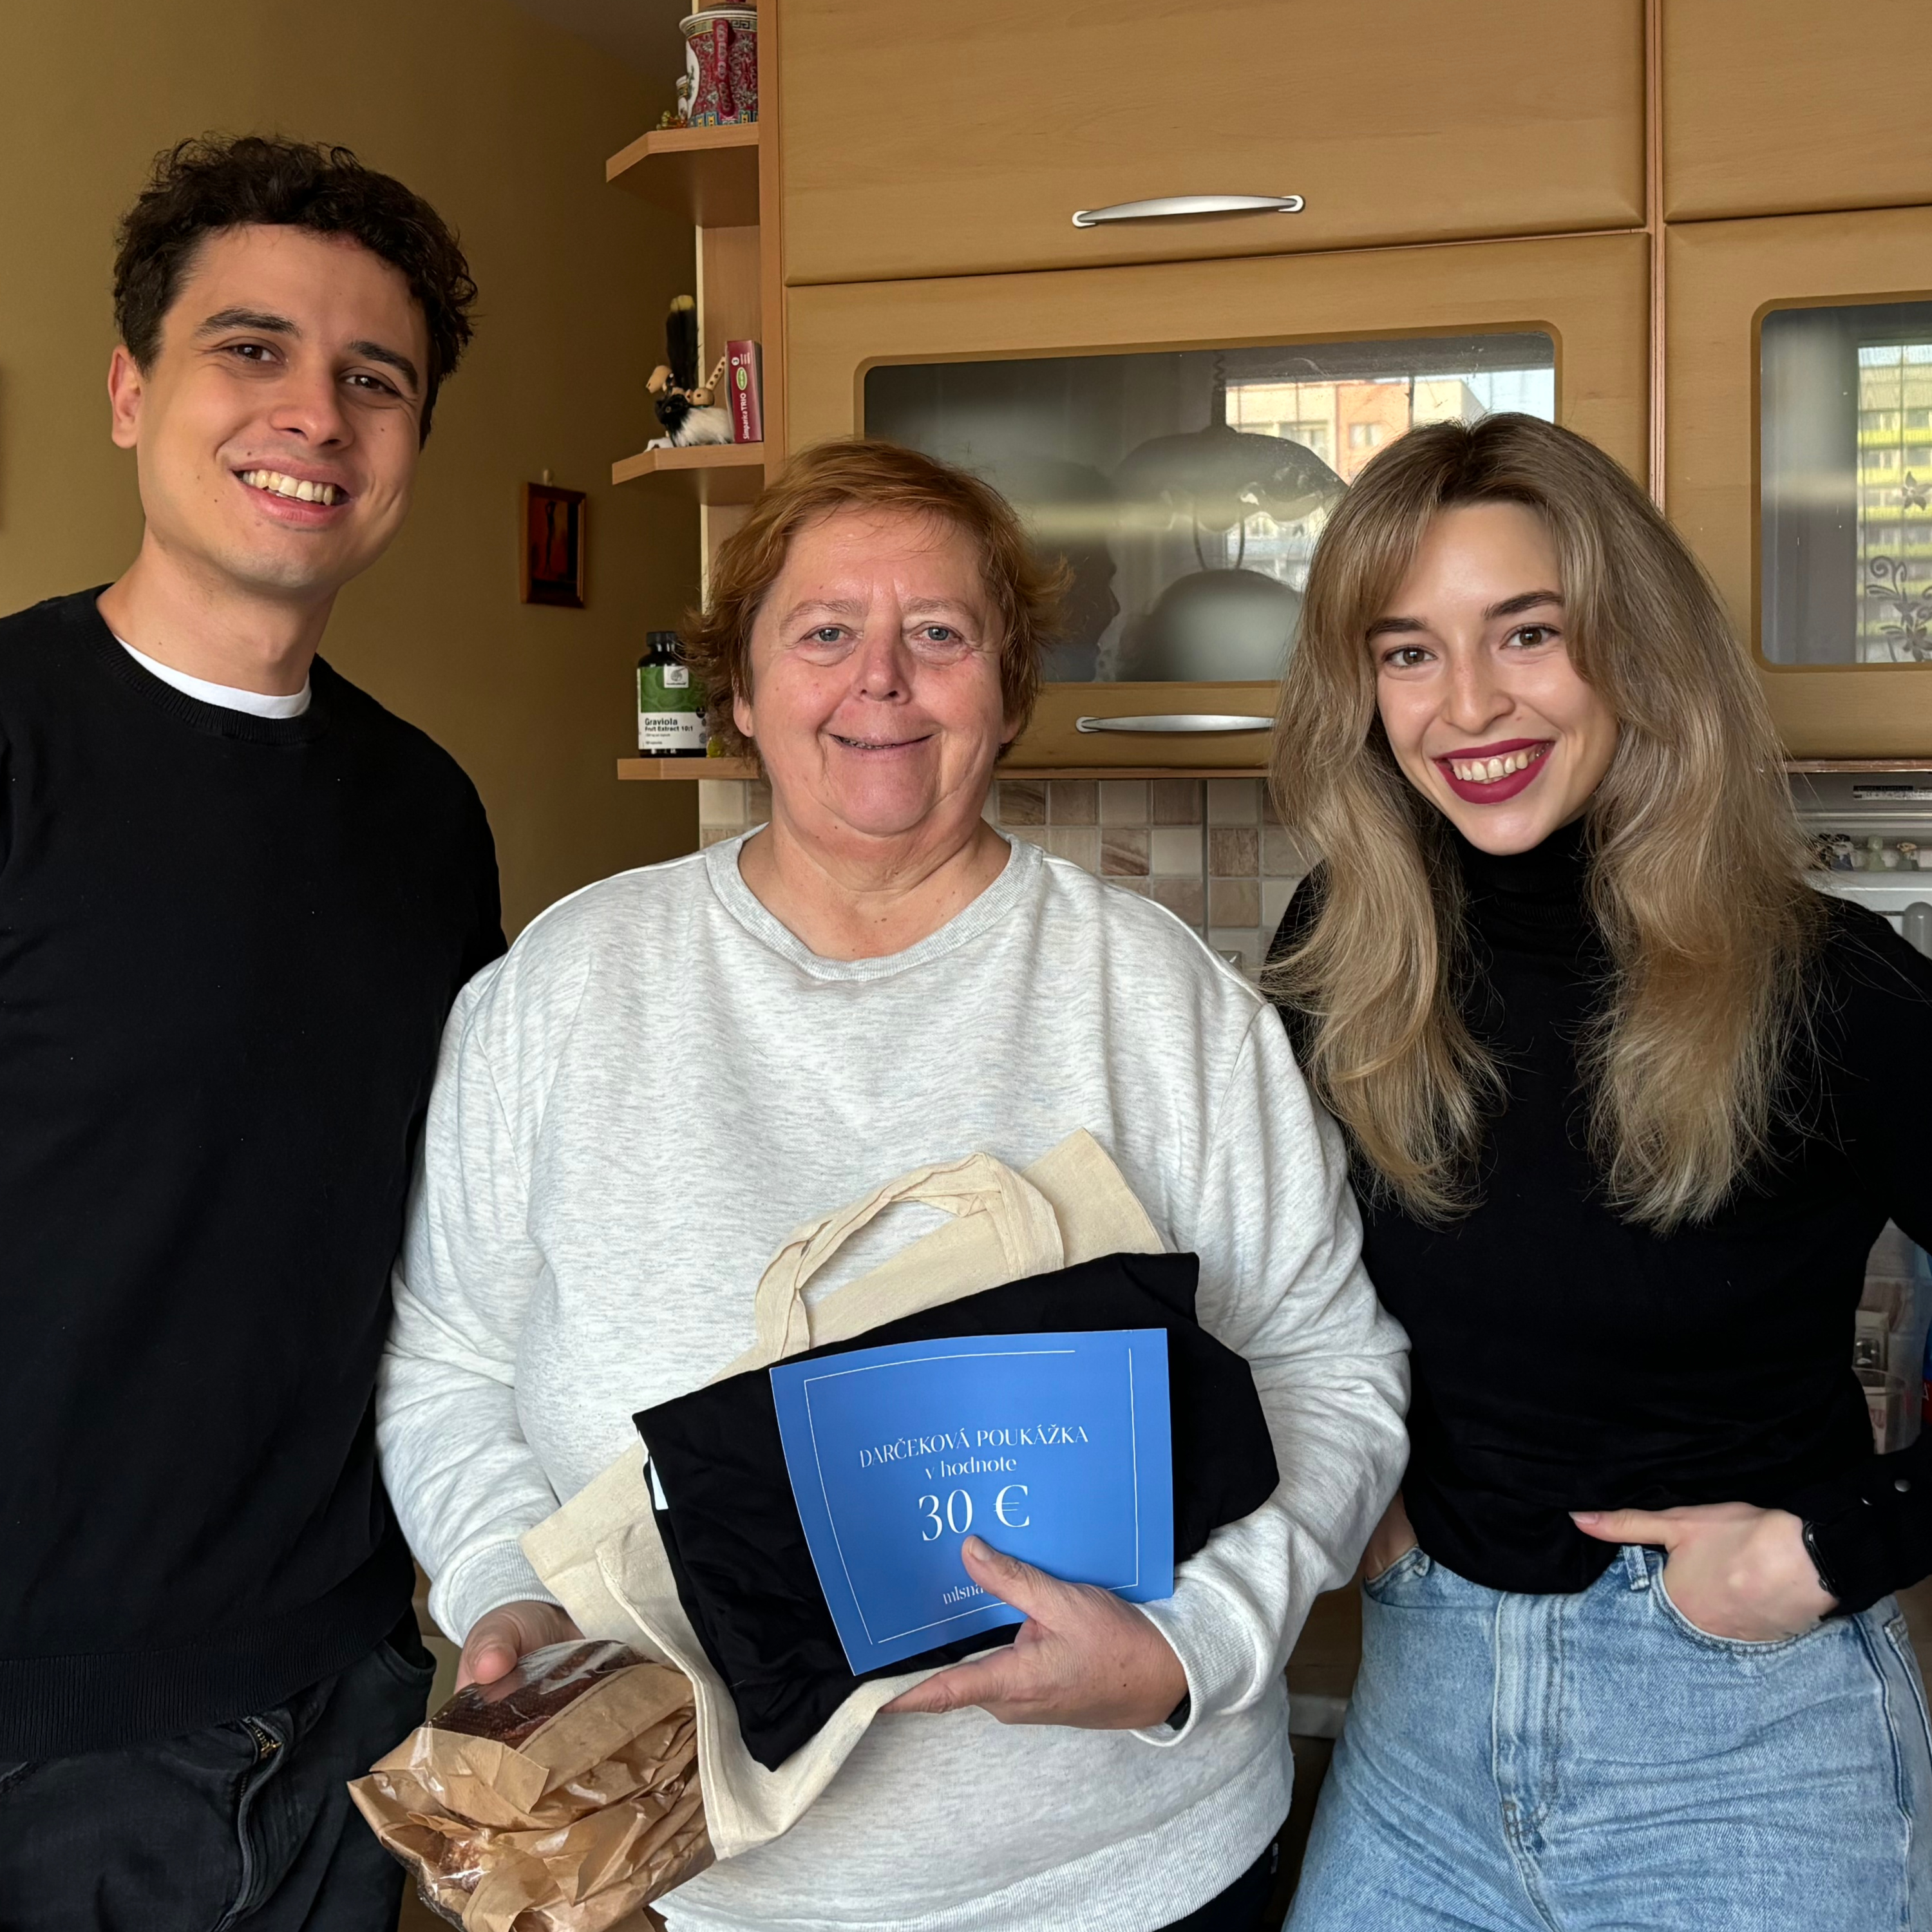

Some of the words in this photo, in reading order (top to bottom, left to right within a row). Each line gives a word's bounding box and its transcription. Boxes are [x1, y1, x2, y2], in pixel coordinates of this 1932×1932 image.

[741, 411, 750, 439] Simparica
[645, 717, 678, 726] Graviola
[860, 1428, 970, 1468] DARČEKOVÁ
[977, 1424, 1089, 1447] POUKÁŽKA
[925, 1466, 935, 1480] v
[941, 1457, 1018, 1477] hodnote
[918, 1489, 973, 1541] 30
[992, 1484, 1030, 1528] €
